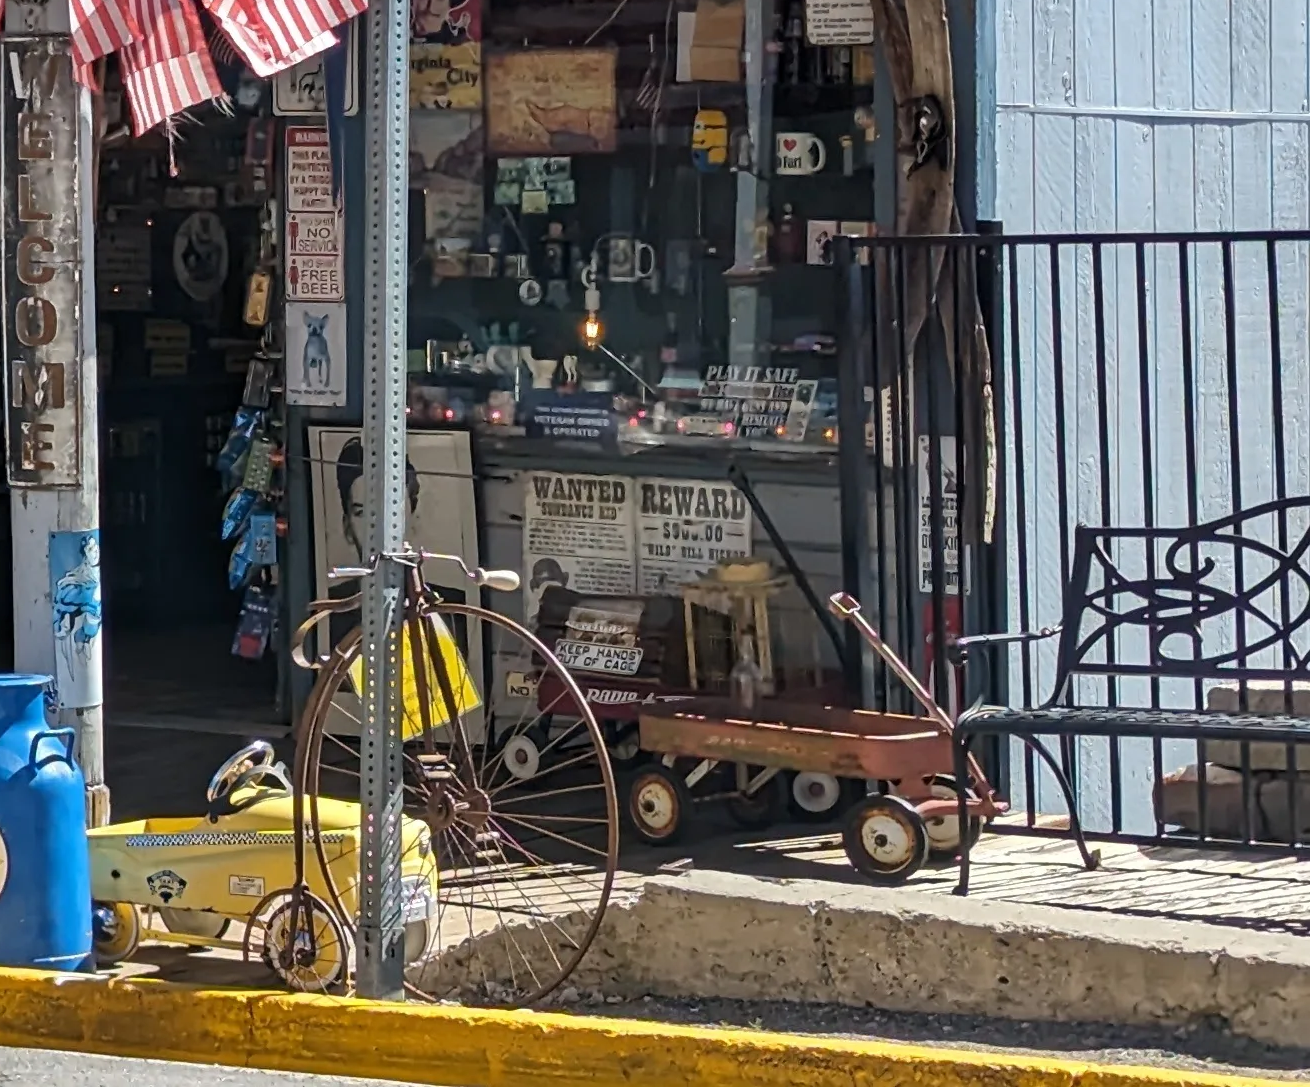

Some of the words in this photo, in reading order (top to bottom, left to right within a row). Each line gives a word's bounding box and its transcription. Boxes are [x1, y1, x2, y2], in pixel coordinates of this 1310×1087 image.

[446, 66, 480, 85] City
[307, 227, 330, 239] NO
[8, 50, 68, 472] WELCOME
[301, 270, 338, 283] FREE
[302, 283, 339, 295] BEER
[707, 365, 741, 383] PLAY
[743, 367, 759, 383] IT
[765, 367, 799, 384] SAFE
[532, 476, 626, 505] WANTED
[641, 483, 746, 520] REWARD
[559, 645, 590, 656] KEEP
[596, 649, 637, 661] HANDS
[556, 653, 577, 664] OUT
[584, 657, 599, 667] OF
[604, 660, 637, 672] CAGE
[510, 685, 530, 697] NO
[586, 688, 638, 705] RADIO
